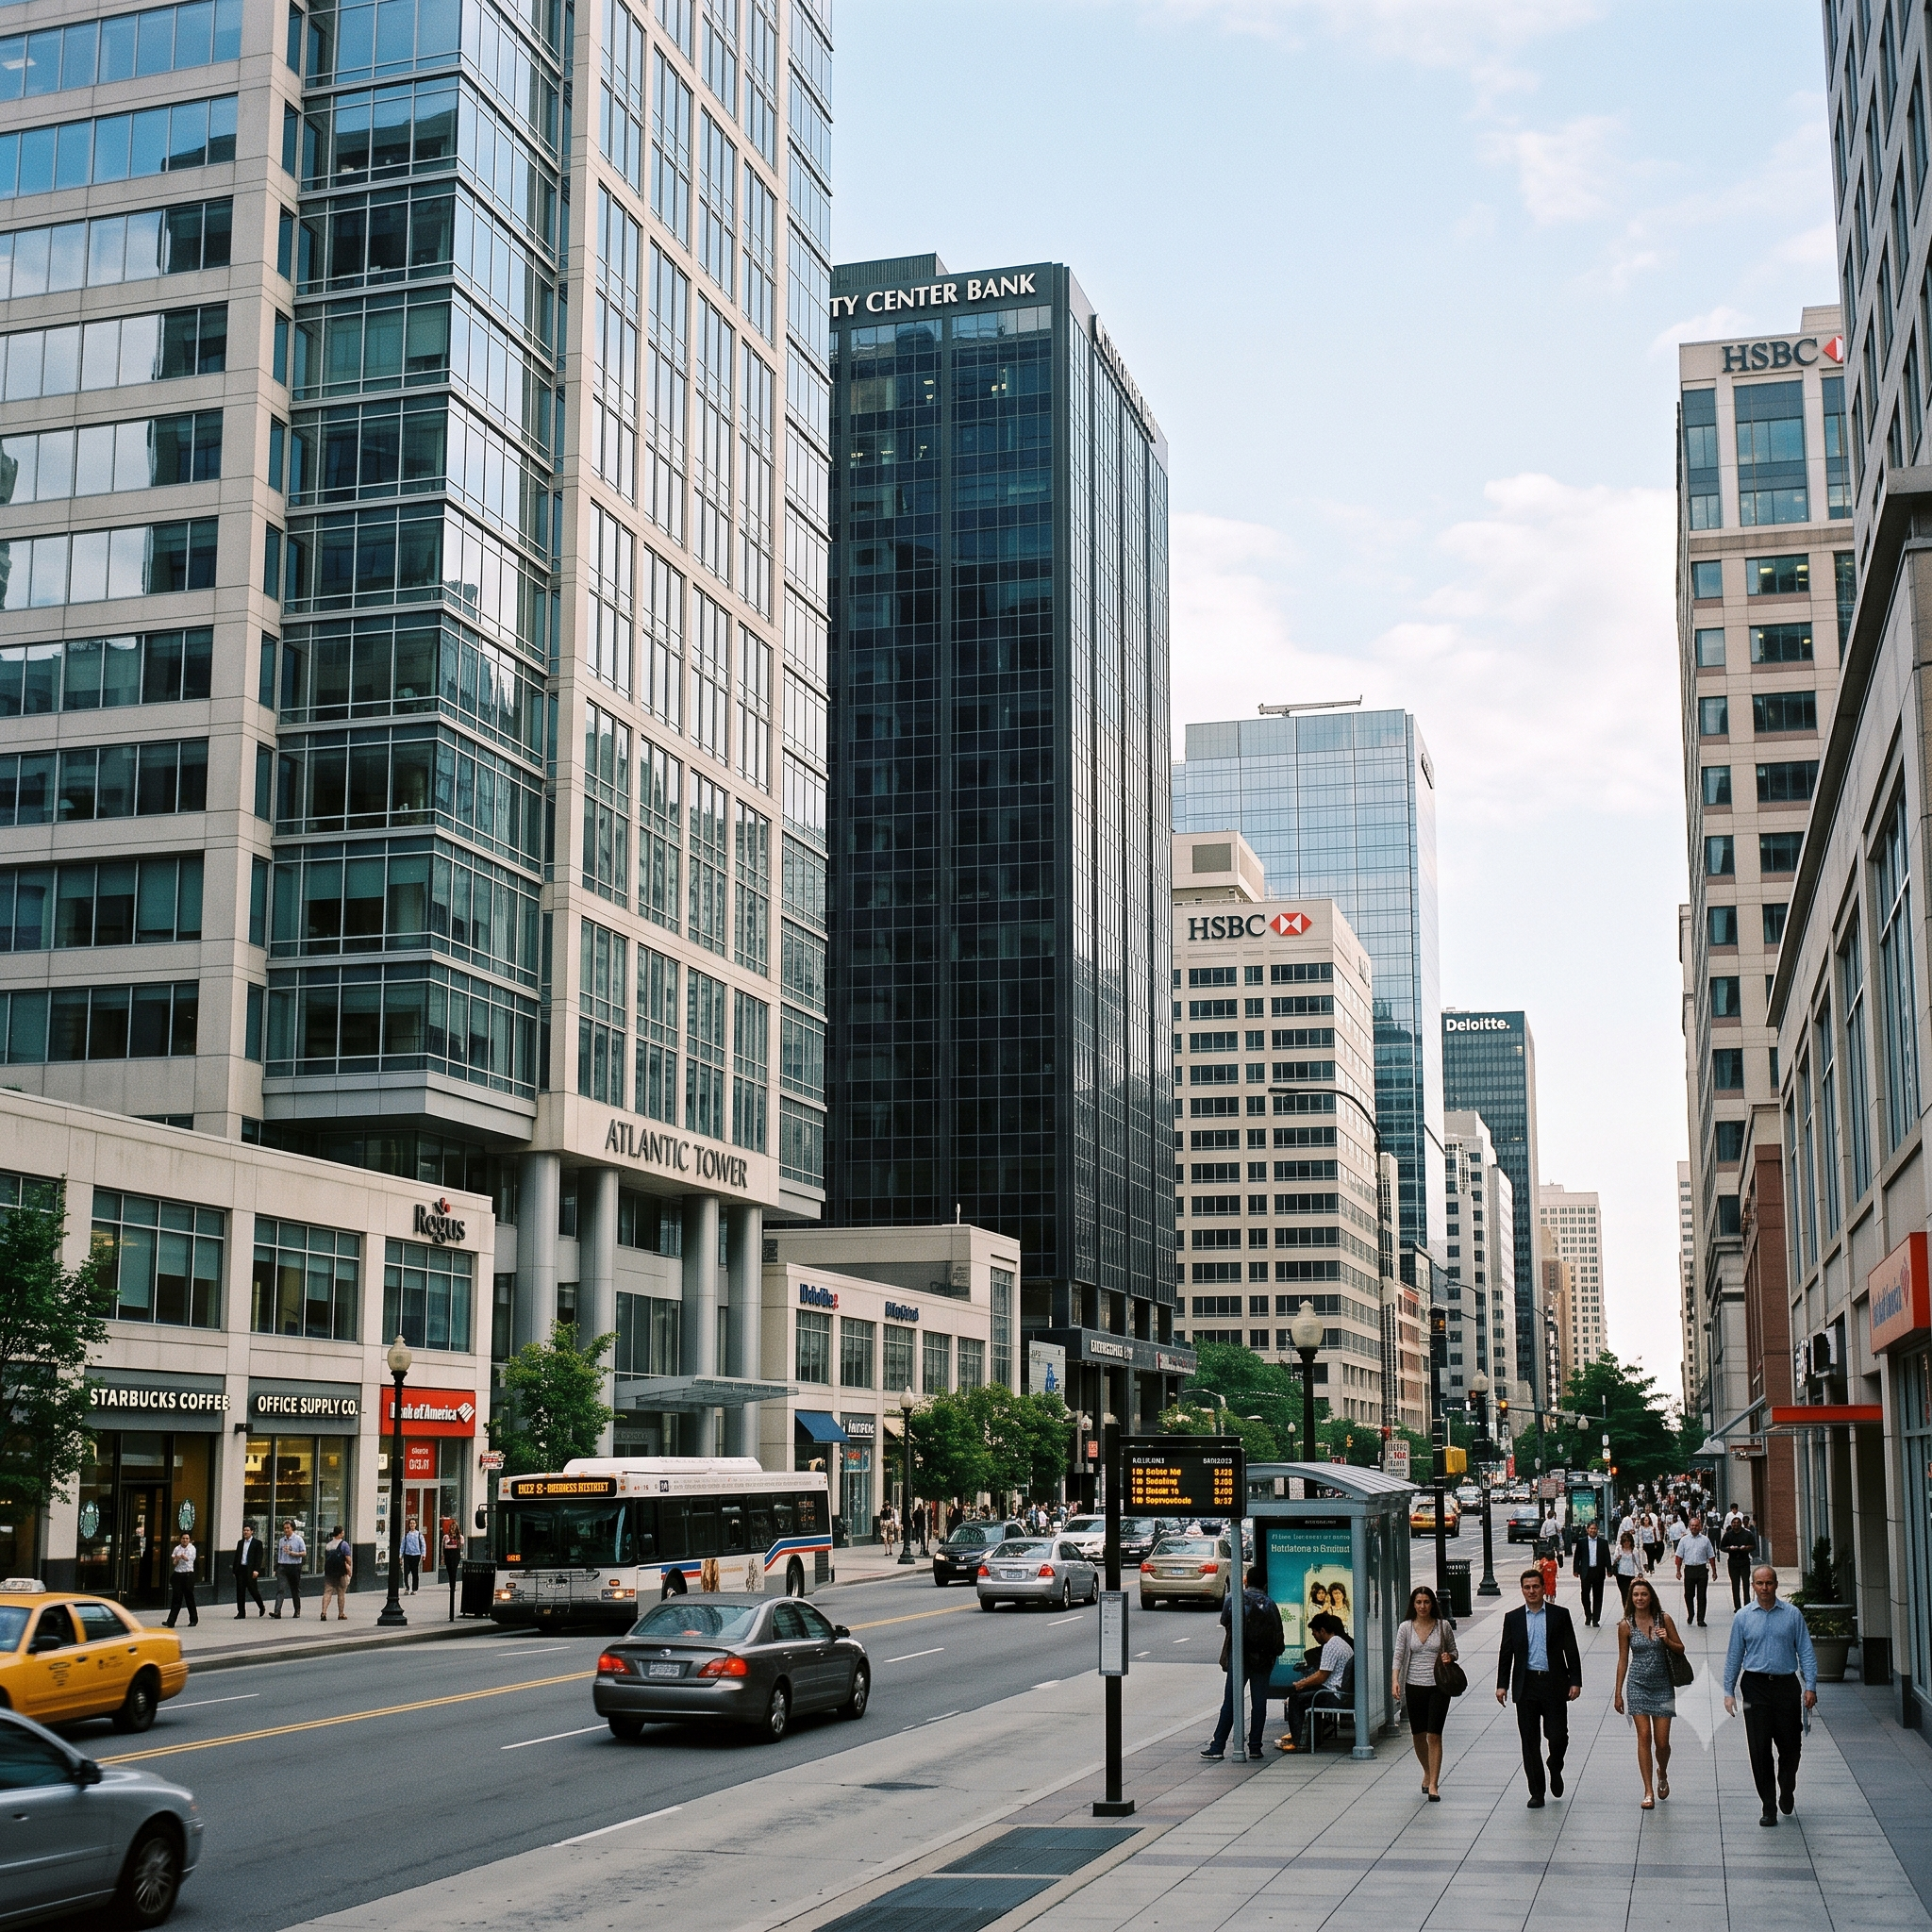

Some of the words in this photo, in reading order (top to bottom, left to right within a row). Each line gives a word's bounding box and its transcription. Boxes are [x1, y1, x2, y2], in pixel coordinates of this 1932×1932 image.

[865, 282, 958, 313] CENTER
[967, 272, 1037, 302] BANK
[1722, 337, 1819, 374] HSBC
[1188, 913, 1266, 941] HSBC
[1445, 1017, 1510, 1032] Deloitte.
[605, 1118, 690, 1172] ATLANTIC
[693, 1143, 748, 1189] TOWER
[89, 1388, 176, 1409] STARBUCKS
[179, 1392, 230, 1411] COFFEE
[258, 1395, 298, 1413] OFFICE
[300, 1397, 341, 1415] SUPPLY
[341, 1399, 358, 1416] CO.
[390, 1402, 414, 1420] nk
[425, 1404, 457, 1421] America
